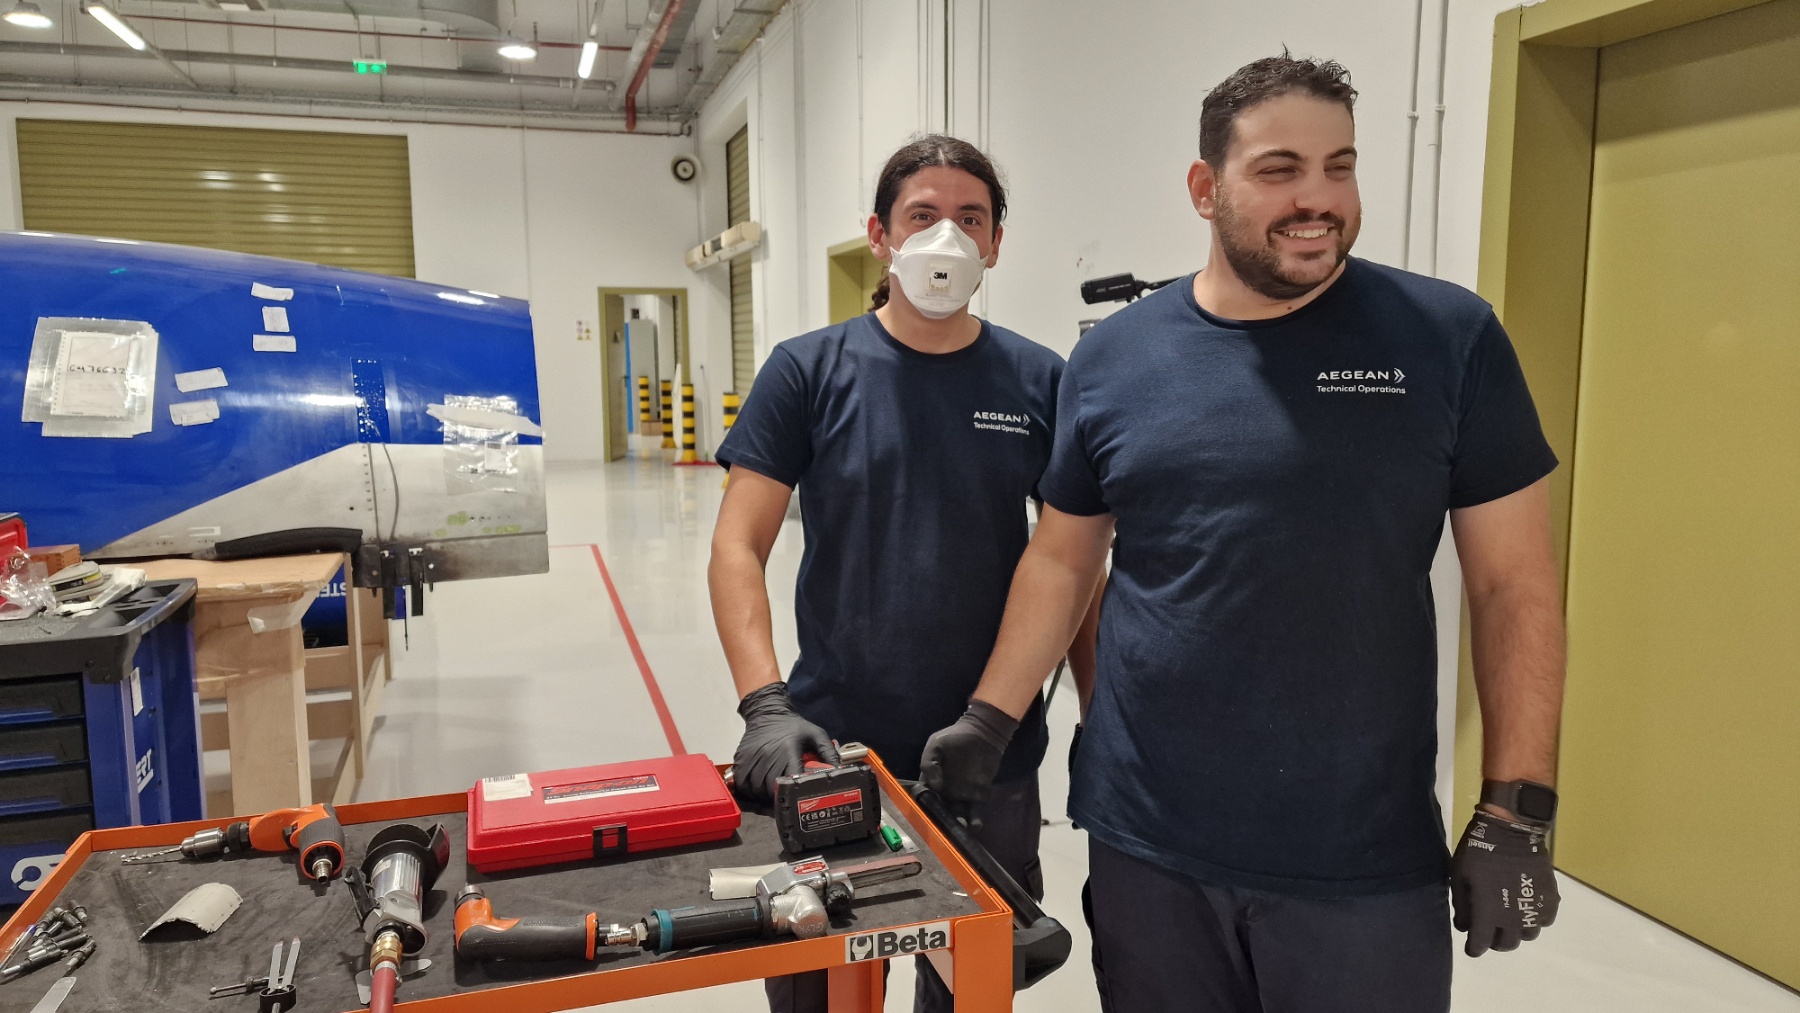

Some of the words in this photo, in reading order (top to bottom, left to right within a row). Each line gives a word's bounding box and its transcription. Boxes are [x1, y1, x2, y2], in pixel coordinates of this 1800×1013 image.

[933, 271, 948, 280] 3M
[1317, 370, 1389, 381] AEGEAN
[1316, 384, 1357, 393] Technical
[1357, 384, 1406, 394] Operations
[973, 411, 1021, 423] AEGEAN
[973, 422, 1001, 431] Technical
[1001, 424, 1030, 436] Operations
[1467, 838, 1495, 852] Ansell
[1517, 877, 1539, 928] HyFlex
[877, 927, 947, 957] Beta
